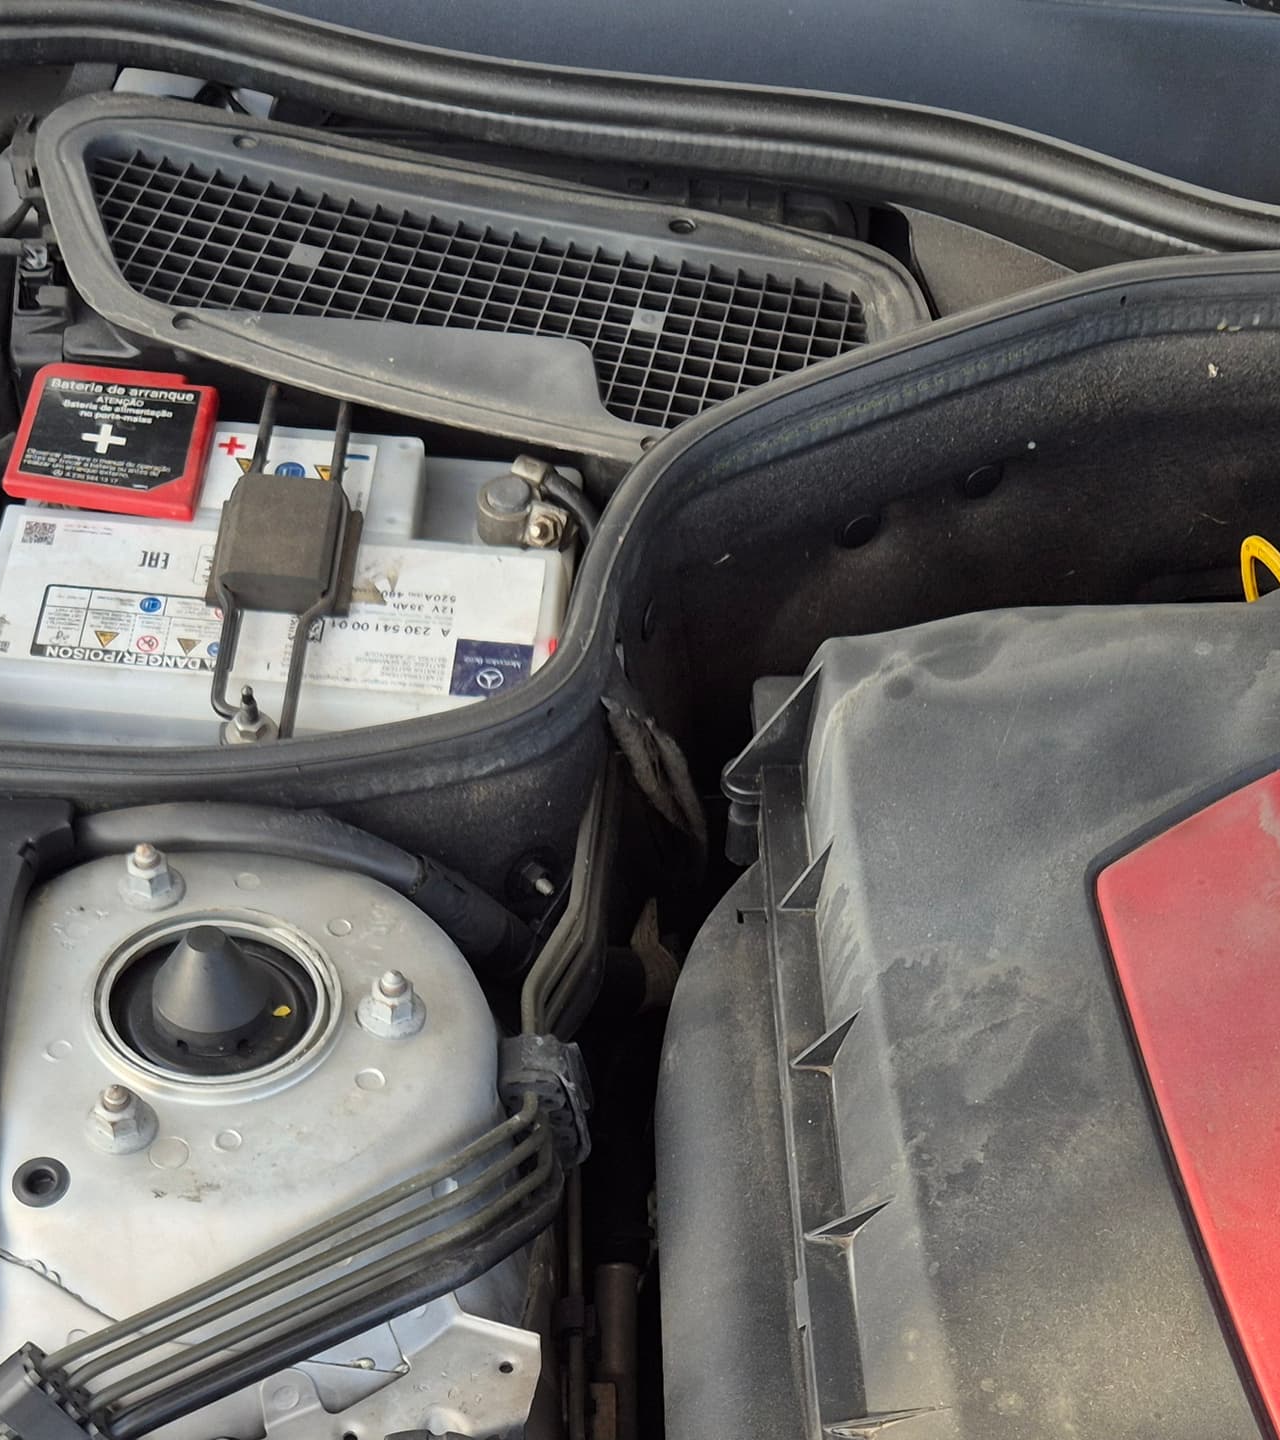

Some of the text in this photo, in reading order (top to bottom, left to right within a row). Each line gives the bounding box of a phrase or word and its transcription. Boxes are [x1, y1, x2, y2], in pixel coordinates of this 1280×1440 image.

[51, 377, 195, 402] Bateria de arranque
[96, 396, 144, 408] ATENÇÃO
[352, 622, 370, 632] 00
[374, 624, 400, 634] 541
[404, 626, 430, 636] 230
[441, 628, 451, 637] A
[45, 645, 202, 670] DANGER/POISON
